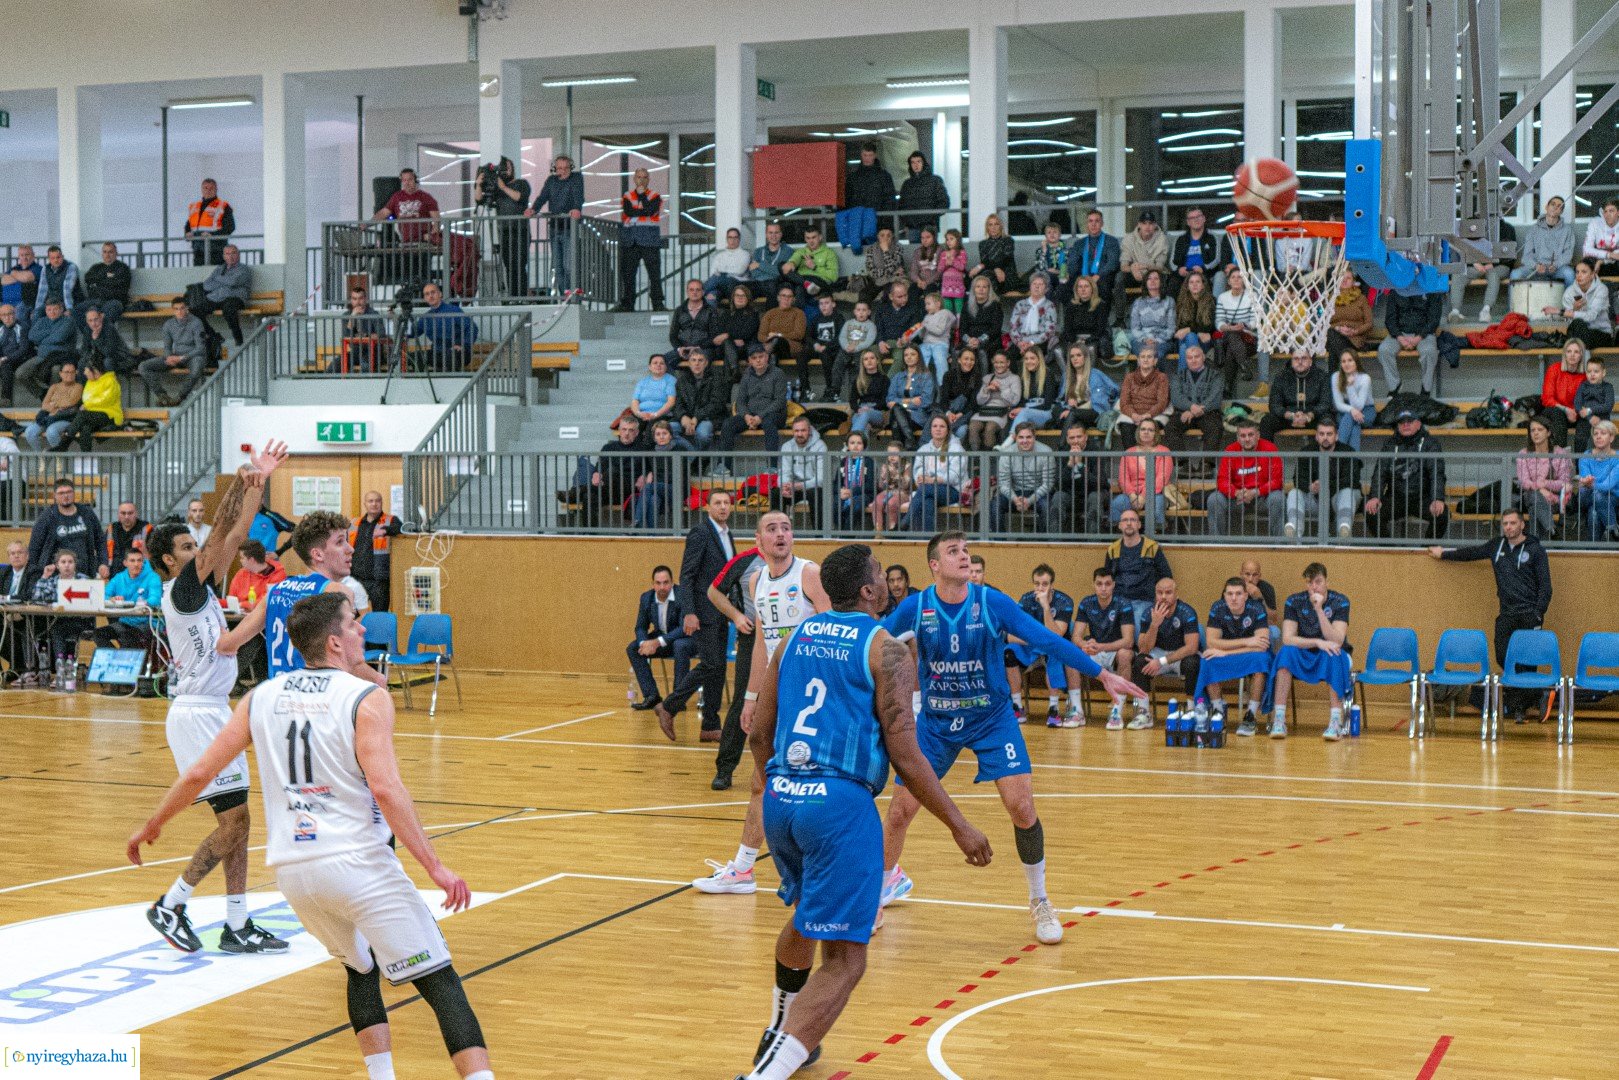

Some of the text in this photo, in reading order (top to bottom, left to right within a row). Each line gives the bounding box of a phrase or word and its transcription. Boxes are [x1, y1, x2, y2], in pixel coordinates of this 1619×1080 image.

[770, 604, 779, 623] 6
[801, 621, 859, 640] KOMETA
[950, 633, 960, 653] 8
[929, 660, 984, 674] KOMETA
[792, 677, 828, 737] 2
[286, 720, 314, 785] 11
[1004, 743, 1017, 760] 8
